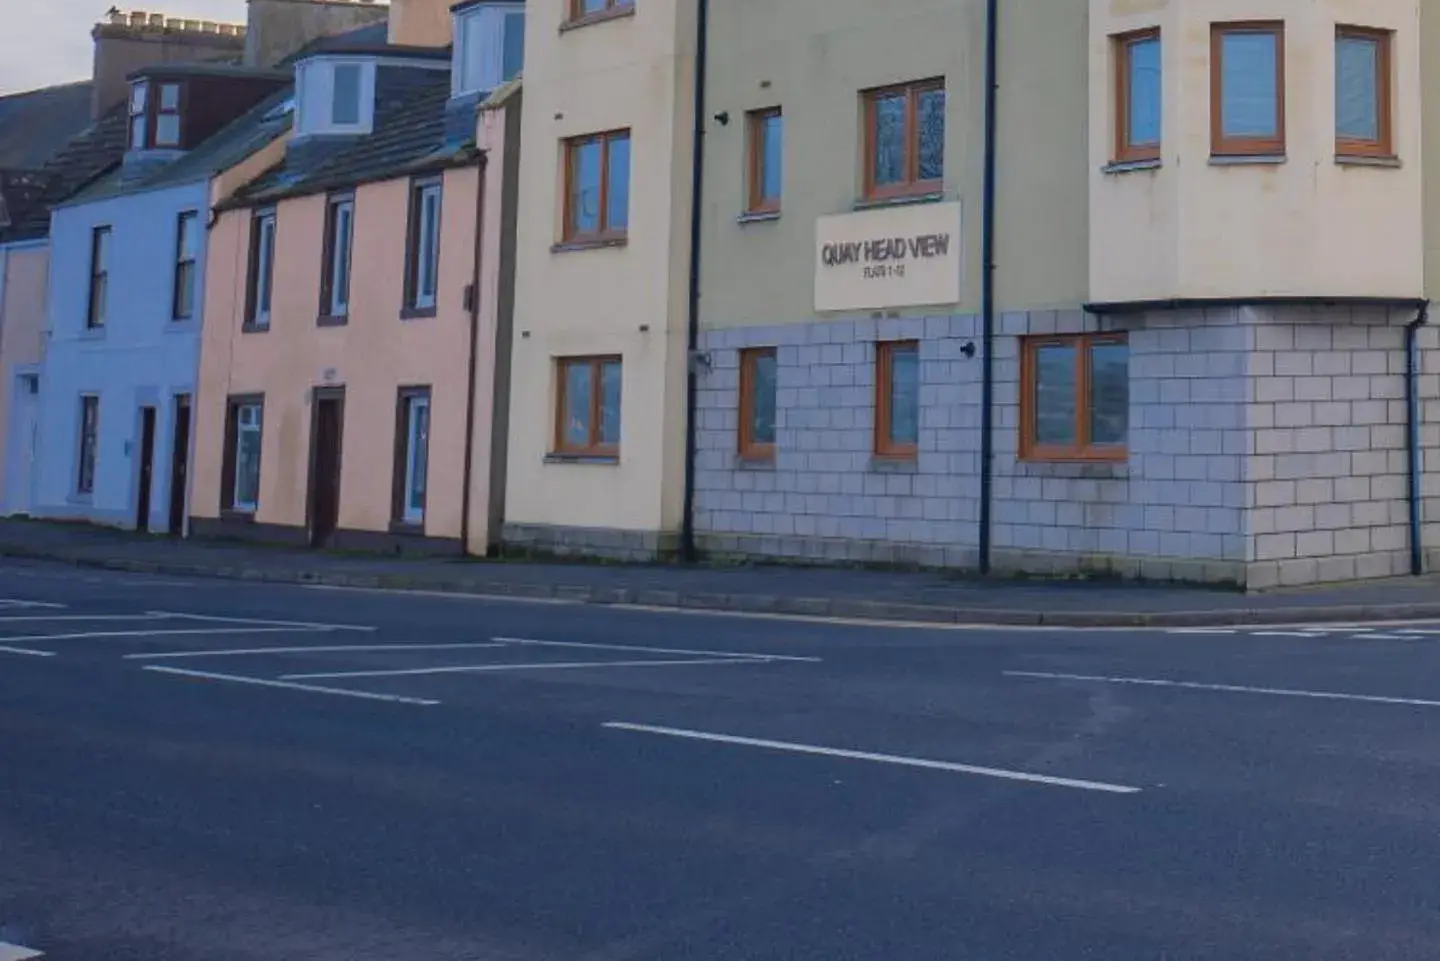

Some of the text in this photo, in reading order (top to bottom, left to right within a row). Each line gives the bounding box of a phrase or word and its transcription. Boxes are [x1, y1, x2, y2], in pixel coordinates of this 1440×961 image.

[822, 233, 950, 267] QUAY HEAD VIEW
